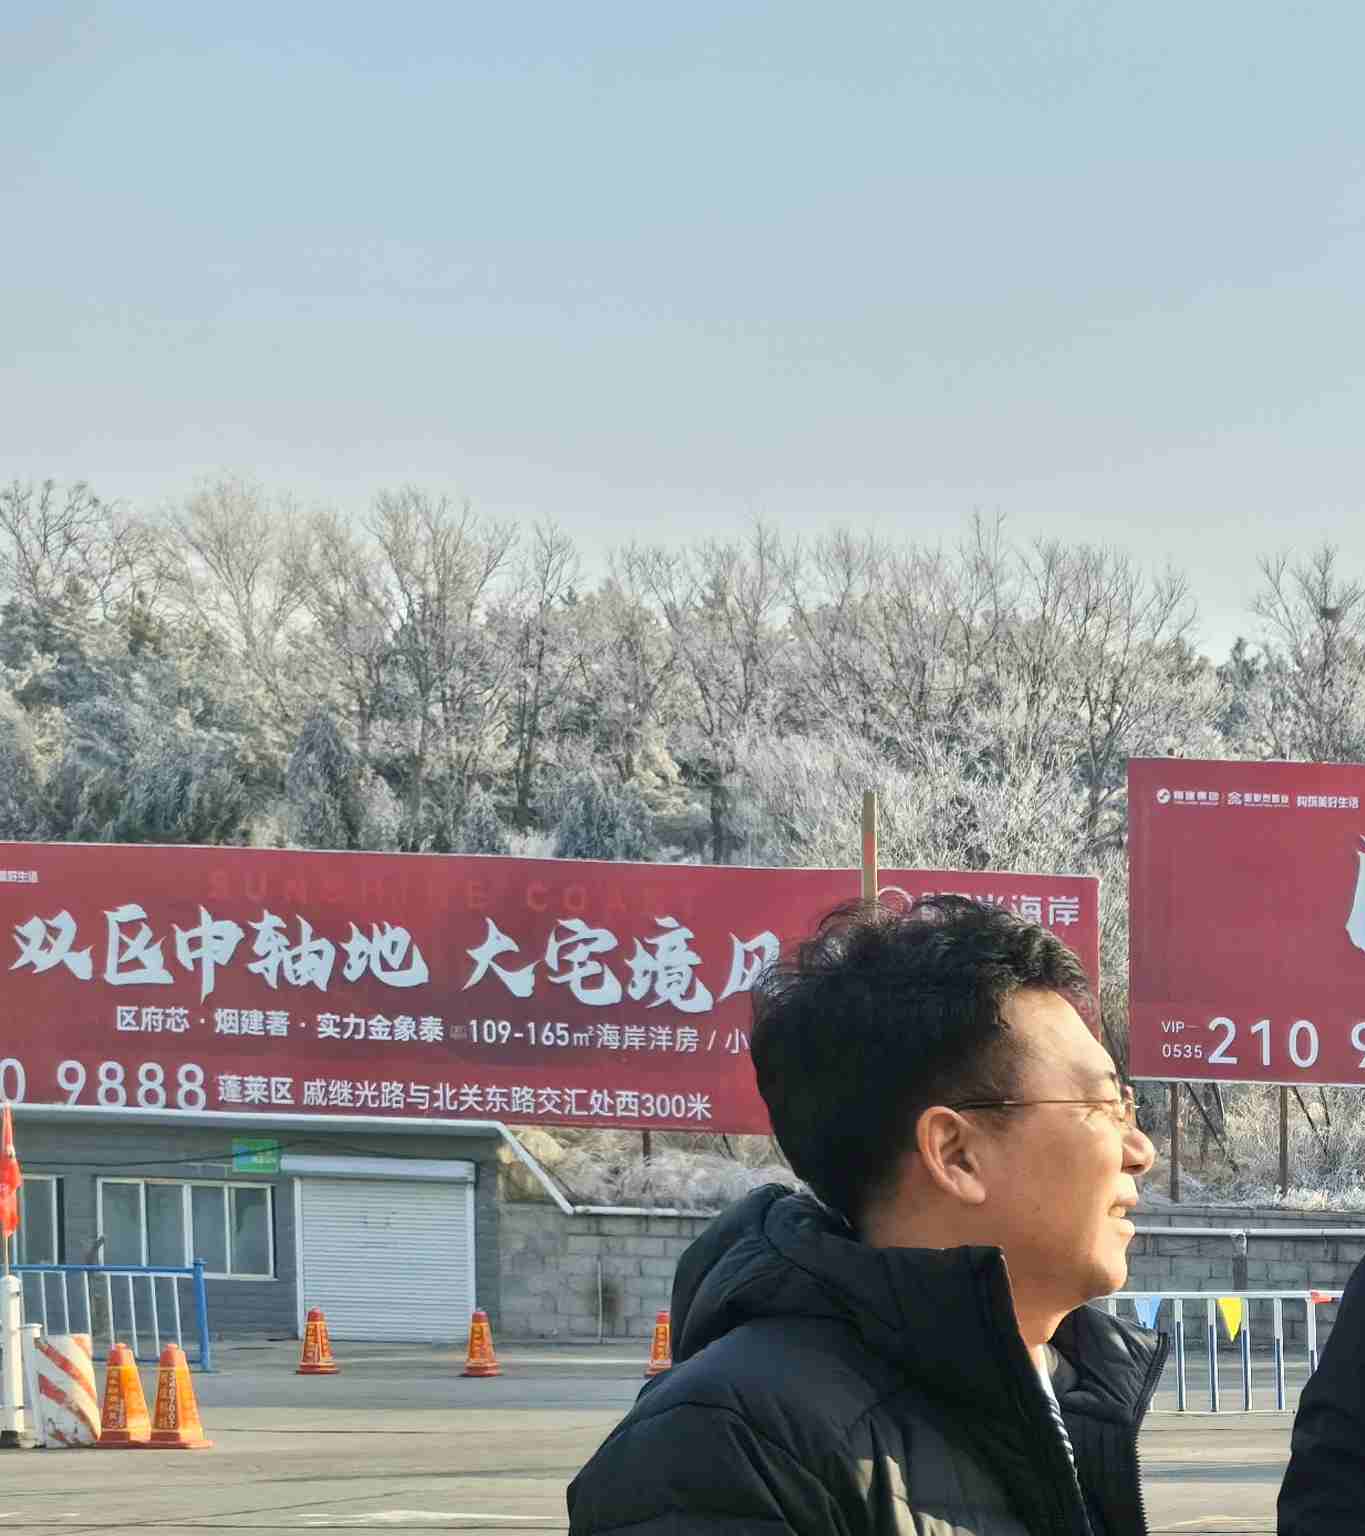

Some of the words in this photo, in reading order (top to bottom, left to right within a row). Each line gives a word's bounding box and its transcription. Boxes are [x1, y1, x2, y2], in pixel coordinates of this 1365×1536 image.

[10, 903, 430, 1003] 双区中轴地
[1161, 1020, 1185, 1033] VIP
[1162, 1044, 1203, 1059] 0535
[1208, 1016, 1319, 1068] 210
[56, 1060, 208, 1110] 9888
[217, 1074, 295, 1105] 蓬莱区
